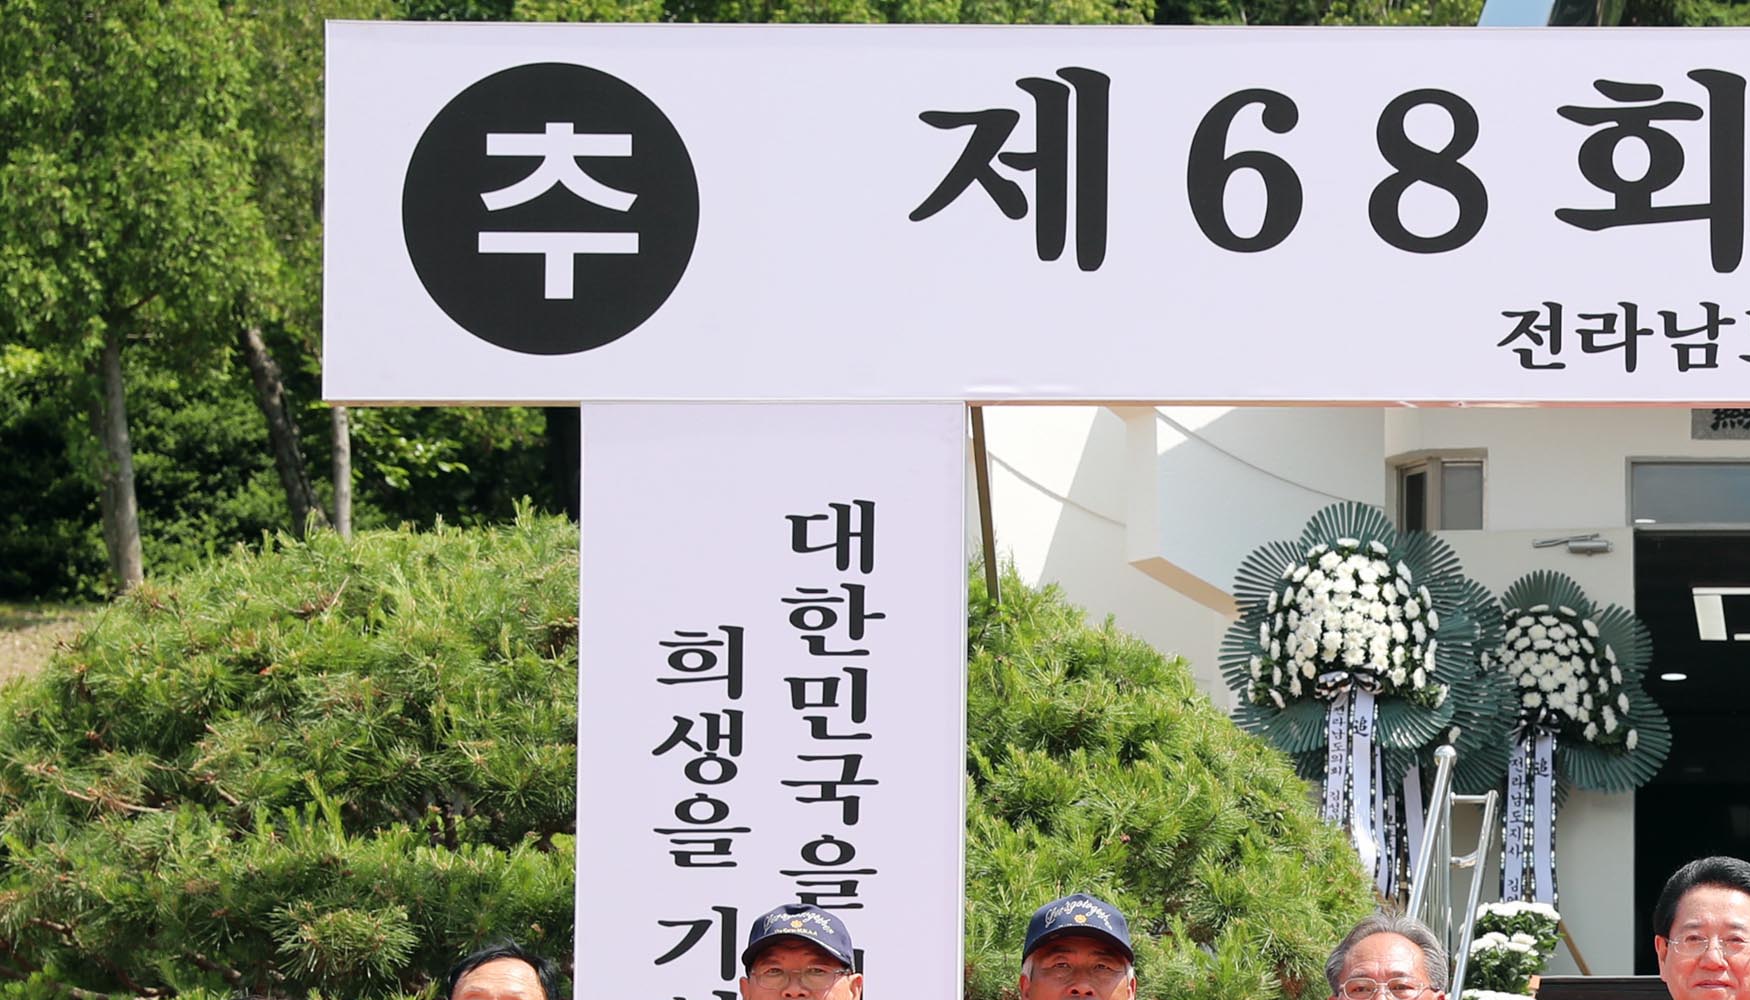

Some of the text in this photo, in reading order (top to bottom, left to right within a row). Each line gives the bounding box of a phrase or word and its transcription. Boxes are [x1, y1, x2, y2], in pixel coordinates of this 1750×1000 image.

[478, 122, 639, 300] 추
[909, 67, 1746, 273] 제68회
[652, 625, 752, 868] 희생을
[779, 500, 886, 909] 대한민국을
